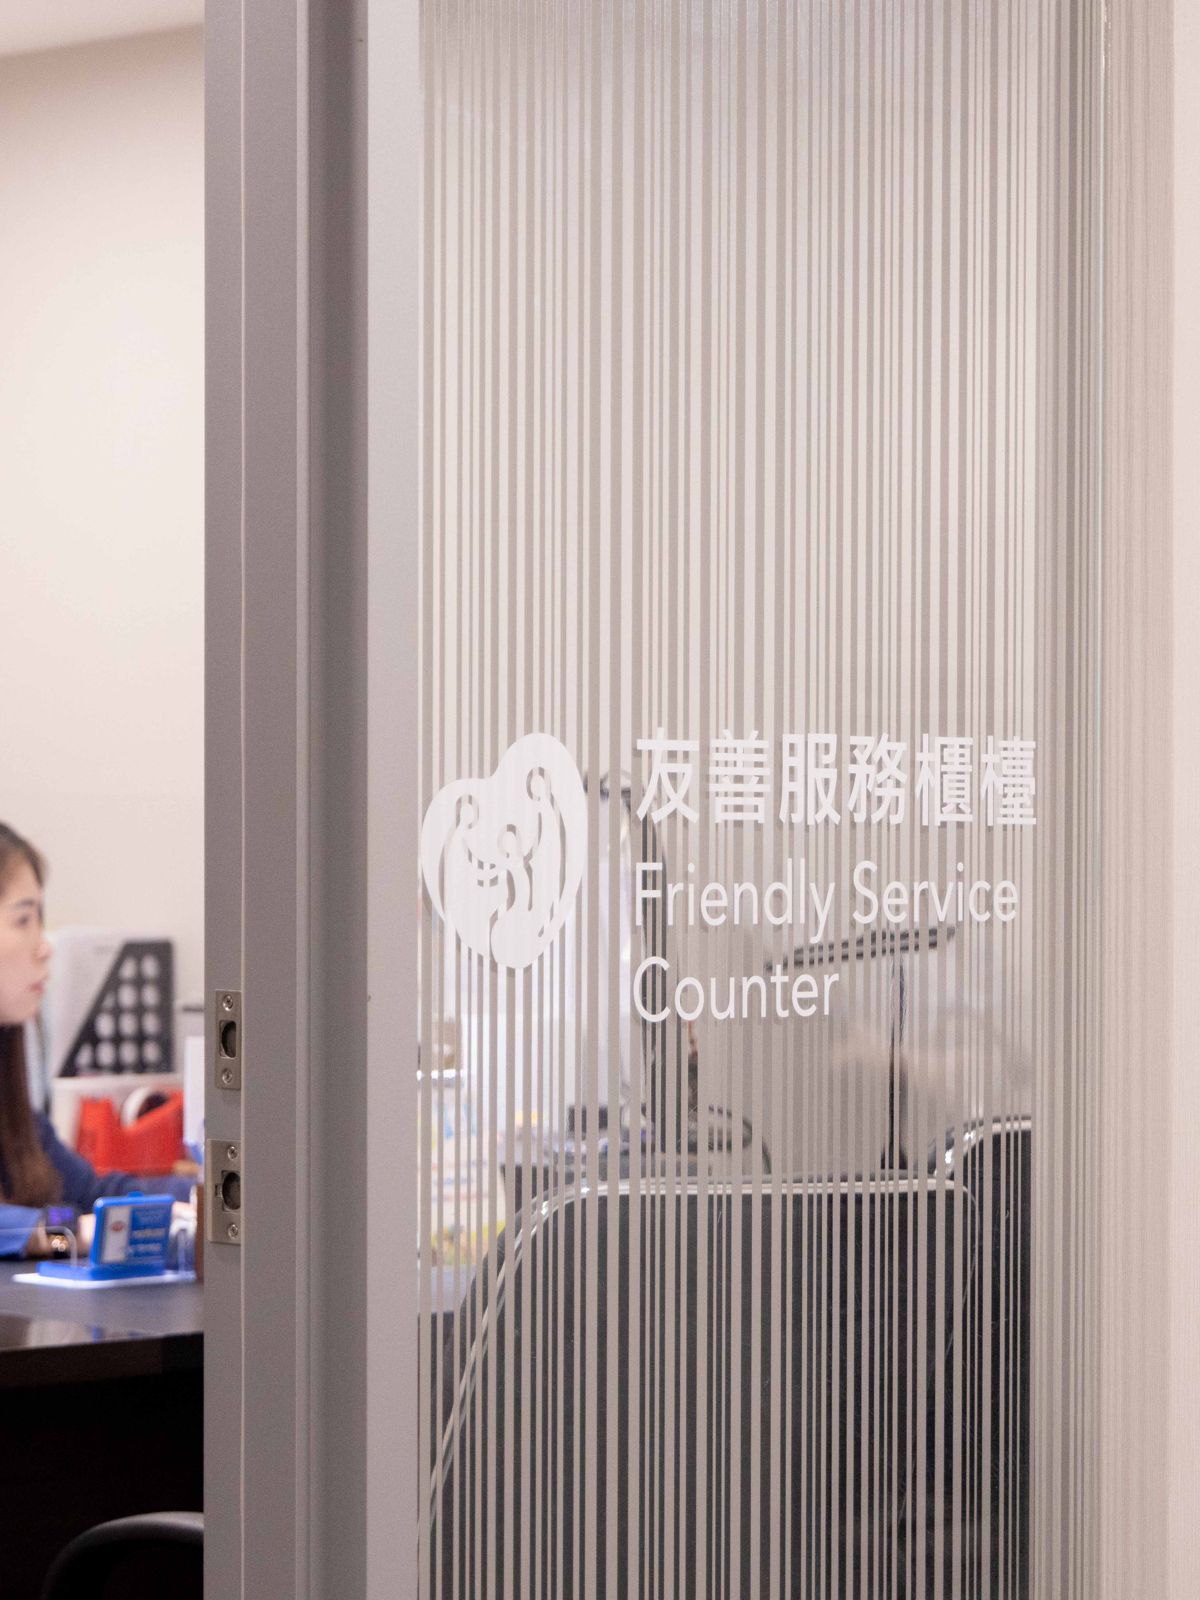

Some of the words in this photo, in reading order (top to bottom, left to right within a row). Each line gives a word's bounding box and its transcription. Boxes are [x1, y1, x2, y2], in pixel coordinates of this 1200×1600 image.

[636, 727, 1037, 827] 友善服務櫃檯
[635, 857, 836, 944] Friendly
[852, 860, 1018, 924] Service
[633, 956, 840, 1023] Counter
